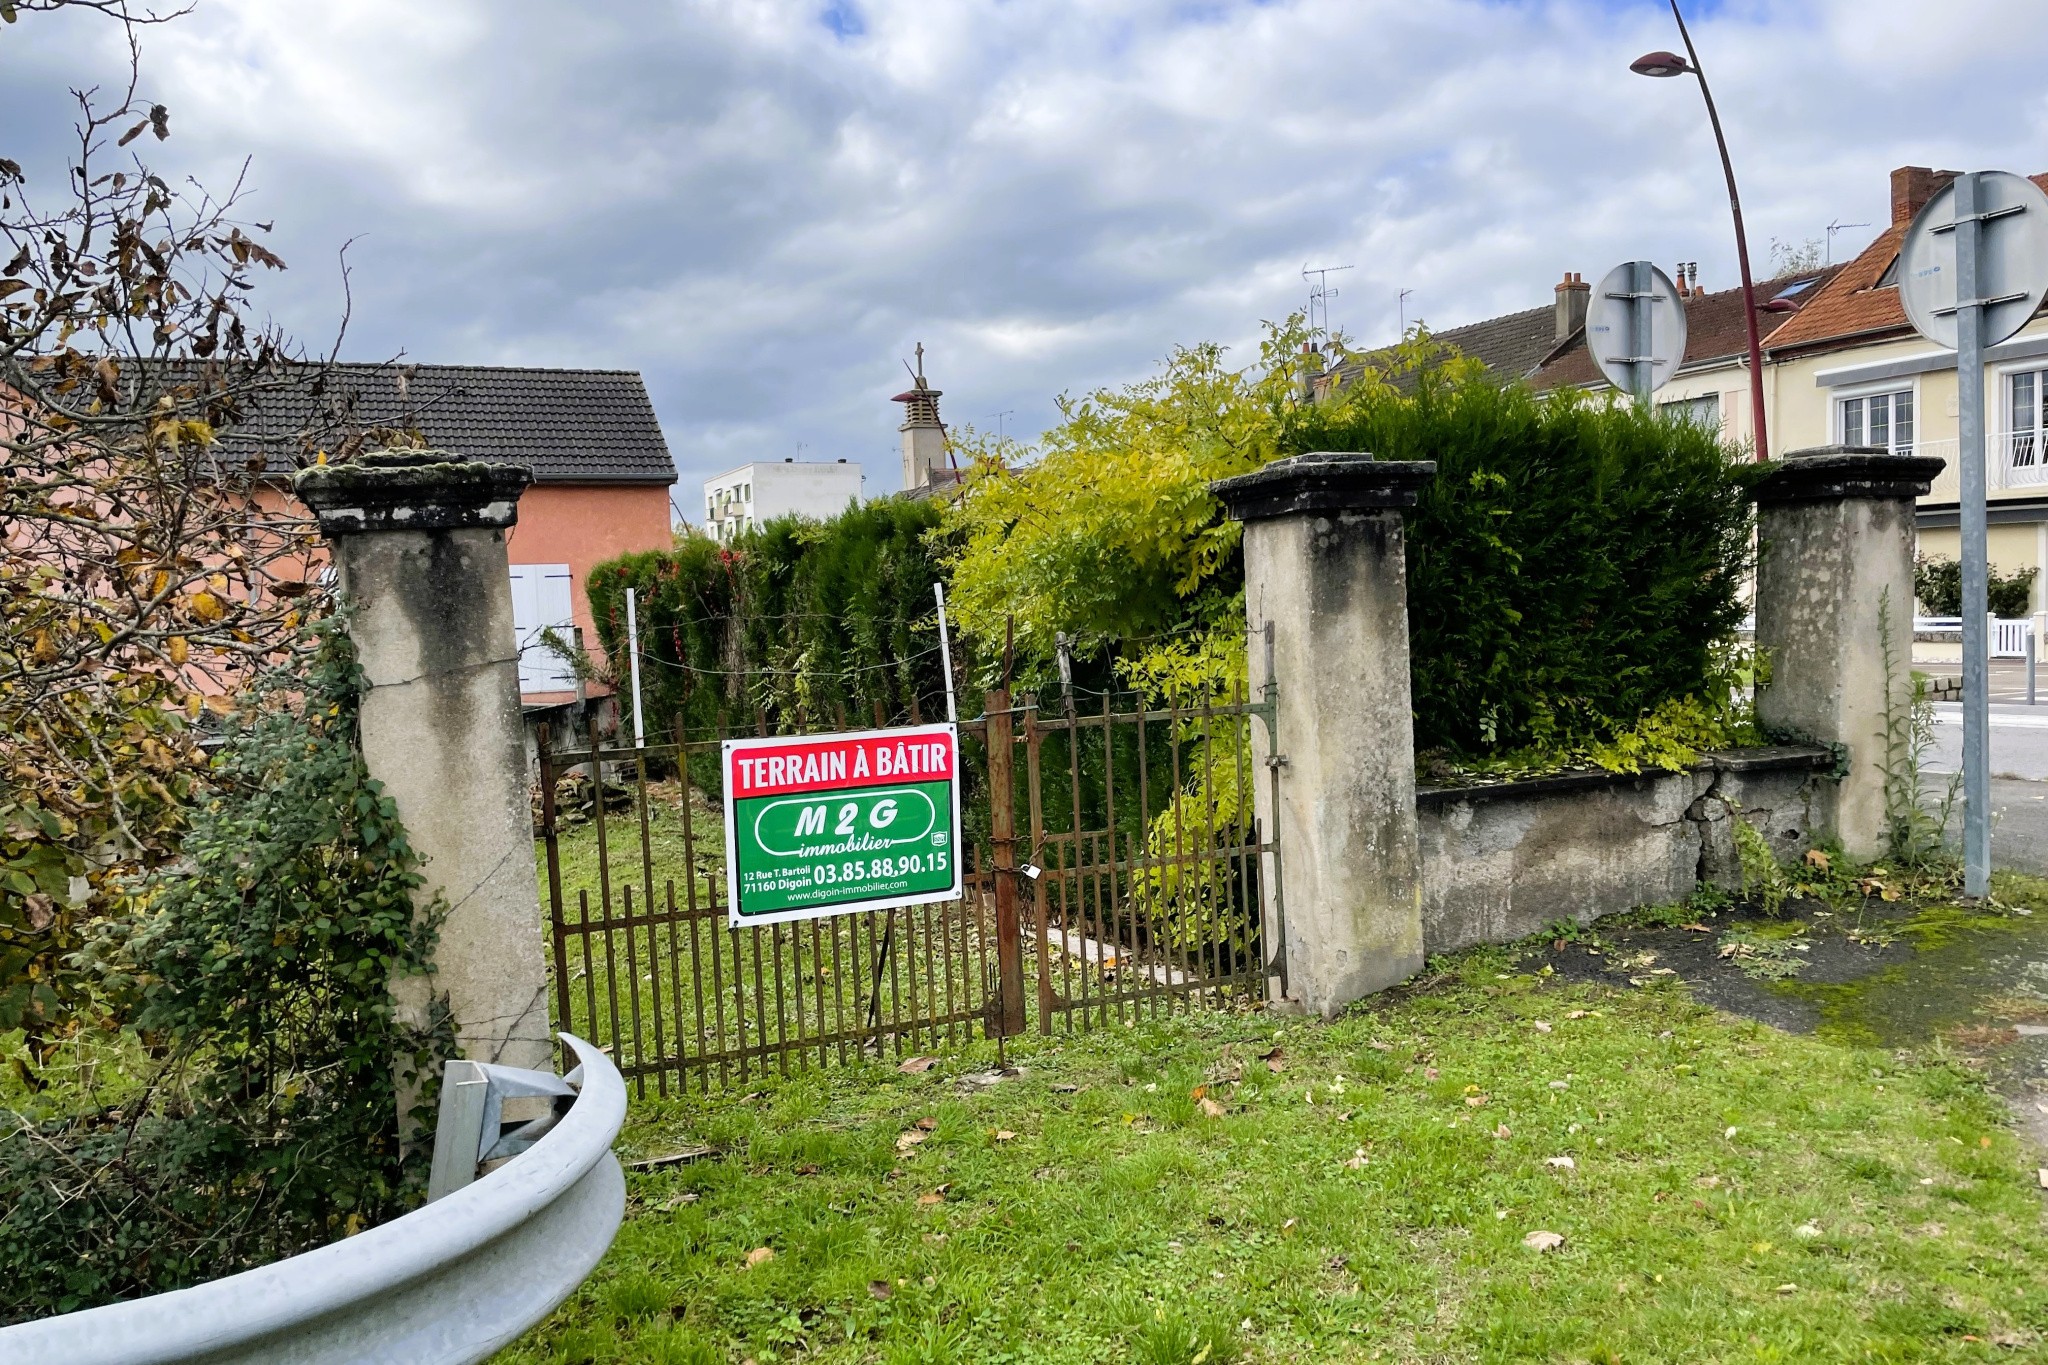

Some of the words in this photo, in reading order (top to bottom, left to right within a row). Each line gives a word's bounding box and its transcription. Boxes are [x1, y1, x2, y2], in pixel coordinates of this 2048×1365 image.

[738, 750, 846, 789] TERRAIN
[853, 744, 870, 778] À
[876, 741, 947, 776] BÂTIR
[794, 804, 827, 837] M
[834, 802, 859, 835] 2
[869, 799, 898, 829] G
[798, 831, 892, 858] immobilier
[744, 872, 754, 881] 12
[756, 870, 773, 880] Rue
[774, 869, 782, 877] T.
[782, 865, 810, 876] Bartoli
[814, 852, 947, 885] 03.85.88.90.15
[744, 881, 776, 894] 71160
[778, 877, 812, 891] Digoin
[787, 879, 908, 901] www.digoin-immobilier.com
